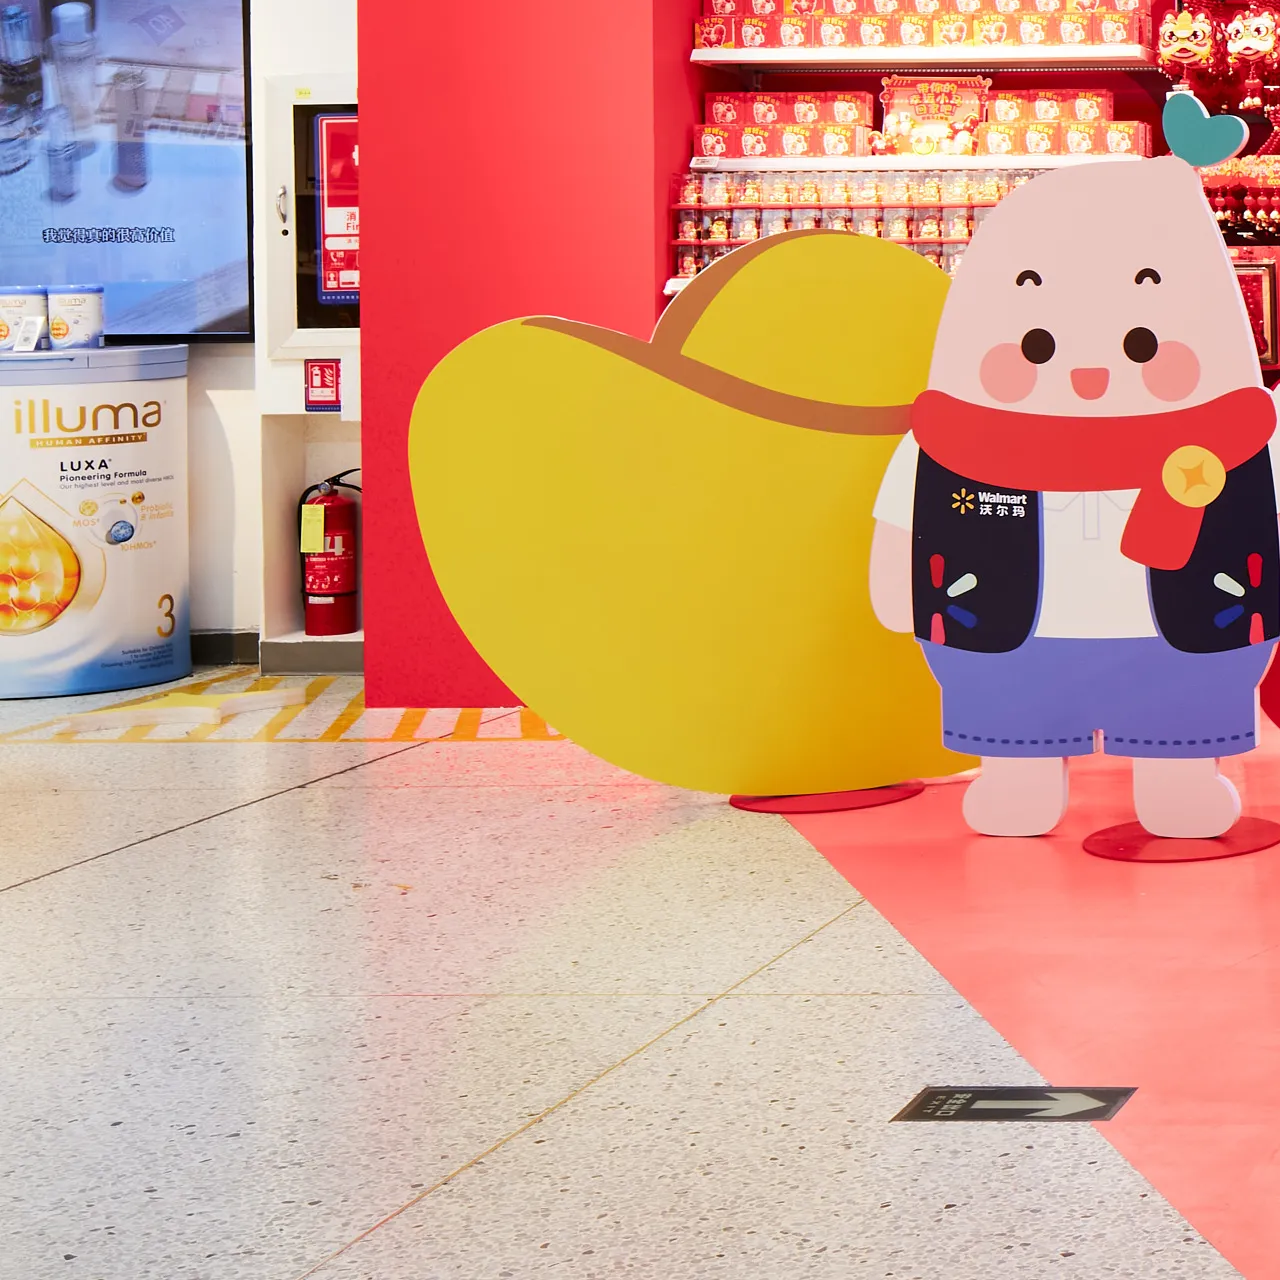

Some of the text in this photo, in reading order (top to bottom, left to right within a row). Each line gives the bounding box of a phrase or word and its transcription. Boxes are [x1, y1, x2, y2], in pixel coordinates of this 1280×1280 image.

[42, 227, 176, 244] 我觉得真的很高价值
[14, 399, 162, 434] illuma
[36, 434, 143, 447] HUMAN AFFINITY
[60, 470, 147, 483] Pioneering Formula
[978, 491, 1028, 506] Walmart
[979, 504, 1026, 518] 沃尔玛
[156, 593, 176, 639] 3
[922, 1095, 947, 1114] EXIT
